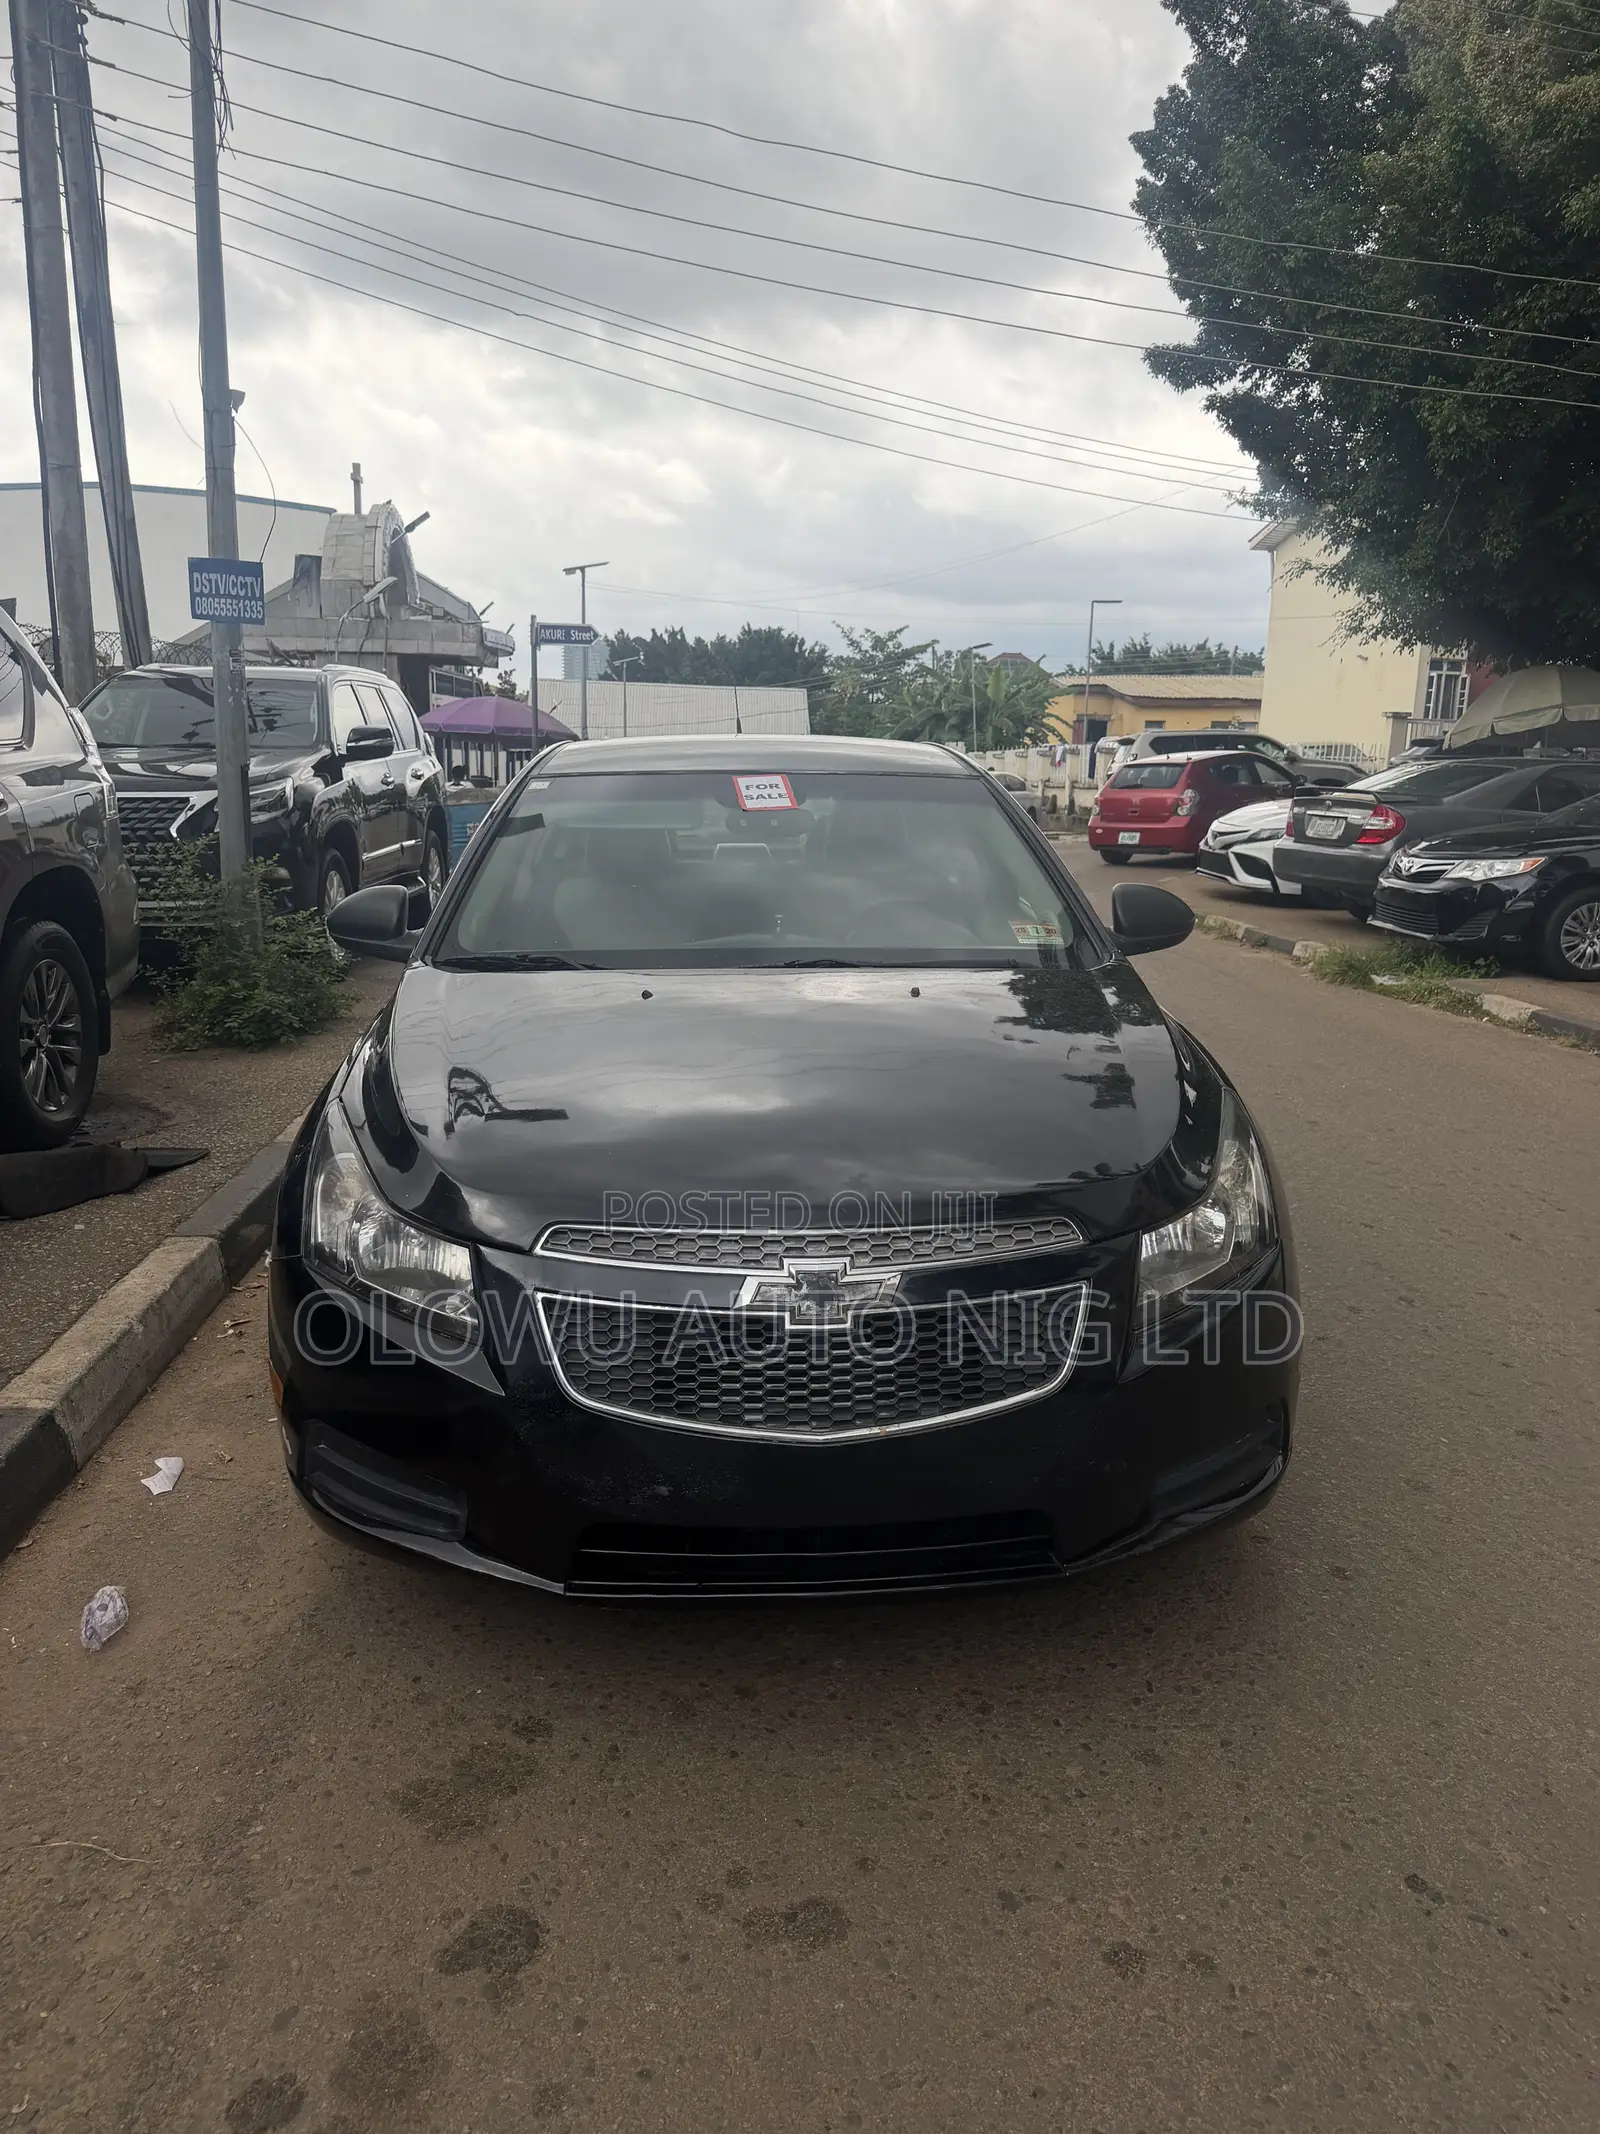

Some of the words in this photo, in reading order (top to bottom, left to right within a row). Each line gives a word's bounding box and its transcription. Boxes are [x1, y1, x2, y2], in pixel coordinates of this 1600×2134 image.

[193, 571, 261, 598] DSTV/CCTV
[195, 596, 264, 619] 08055551335
[570, 629, 595, 641] Street
[744, 783, 781, 791] FOR
[743, 792, 789, 801] SALE
